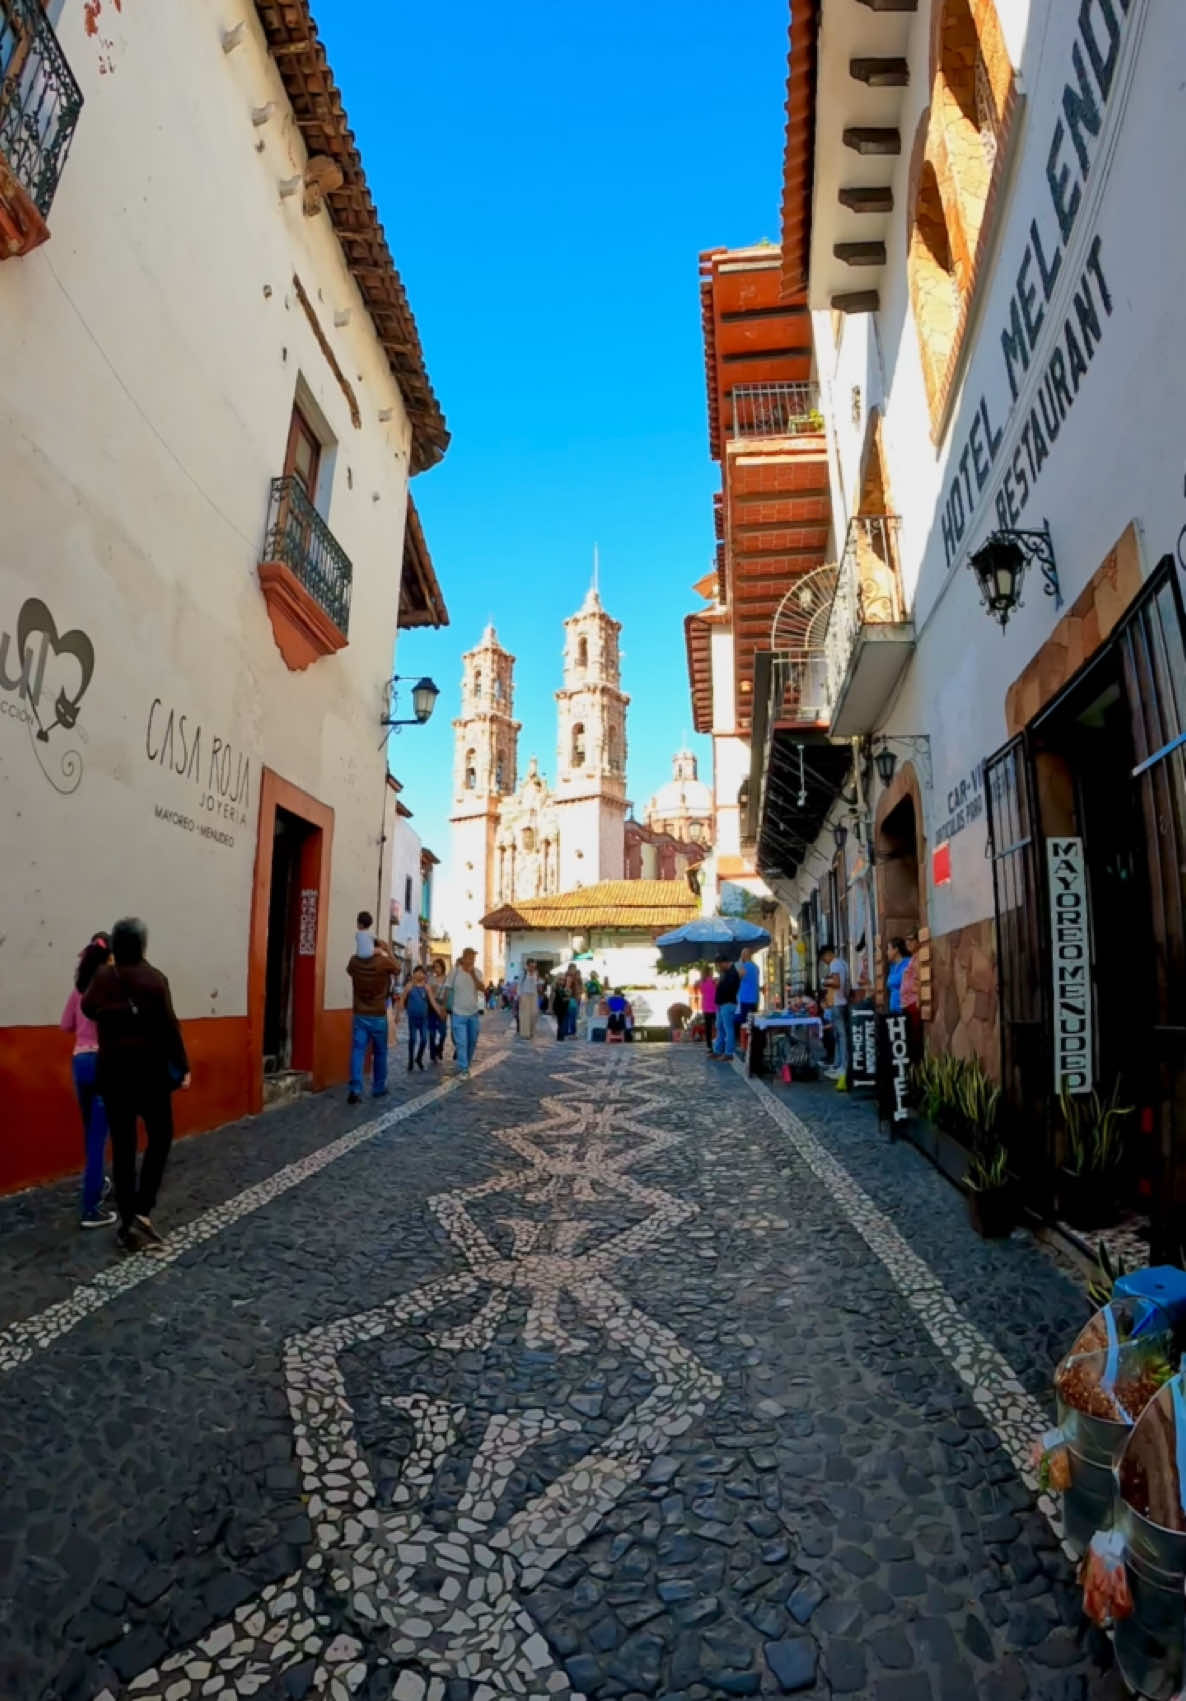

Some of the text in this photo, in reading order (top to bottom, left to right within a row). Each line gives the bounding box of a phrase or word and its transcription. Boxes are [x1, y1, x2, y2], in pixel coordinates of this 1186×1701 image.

[942, 0, 1129, 568] HOTEL MELEND
[996, 235, 1113, 532] RESTAURANT
[146, 698, 250, 808] CASA ROJA
[200, 791, 248, 827] JOYERIA
[154, 804, 235, 848] MAYOREO MENUDEO
[1052, 842, 1083, 960] MAYOREO
[886, 1016, 910, 1121] HOTEL
[1059, 965, 1087, 1089] MENUDEO
